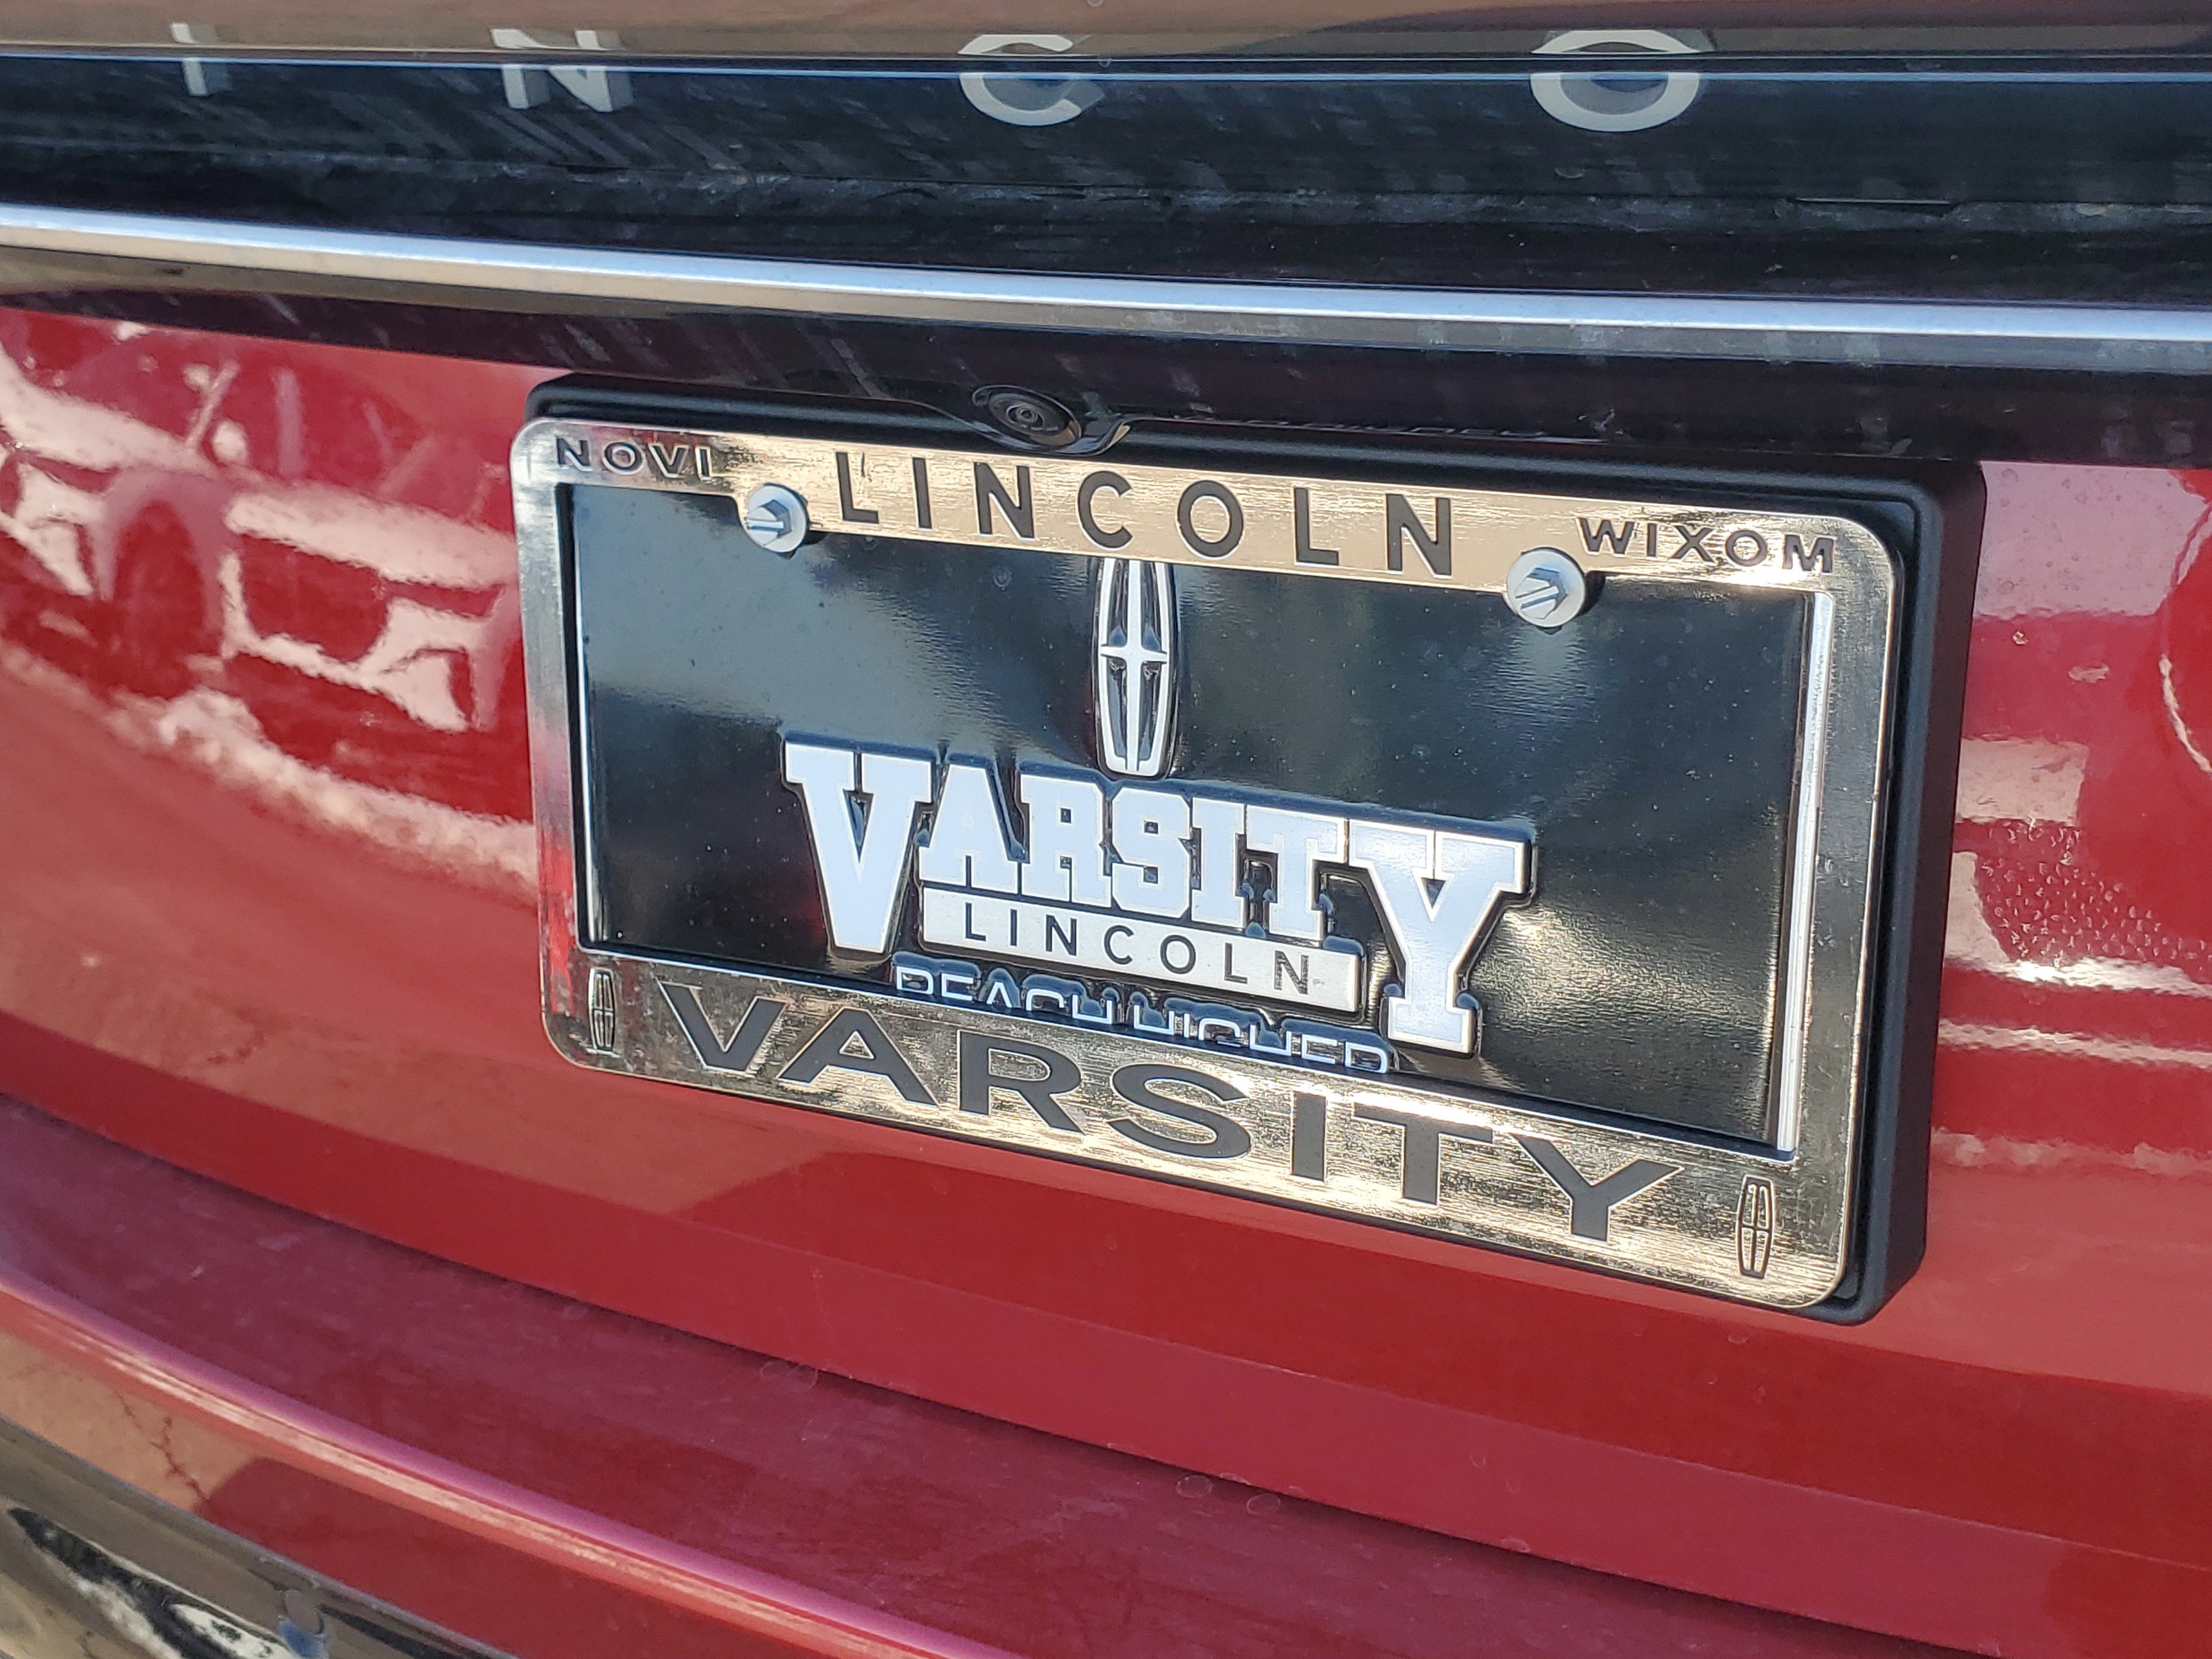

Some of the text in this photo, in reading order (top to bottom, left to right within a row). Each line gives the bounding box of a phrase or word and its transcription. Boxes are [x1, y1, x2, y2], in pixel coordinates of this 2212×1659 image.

[555, 436, 713, 481] NOVI
[836, 452, 1452, 577] LINCOLN
[1578, 516, 1835, 574] WIXOM
[785, 741, 1528, 1054] VARSITY
[964, 901, 1310, 996] LINCOLN
[657, 978, 1684, 1242] VARSITY
